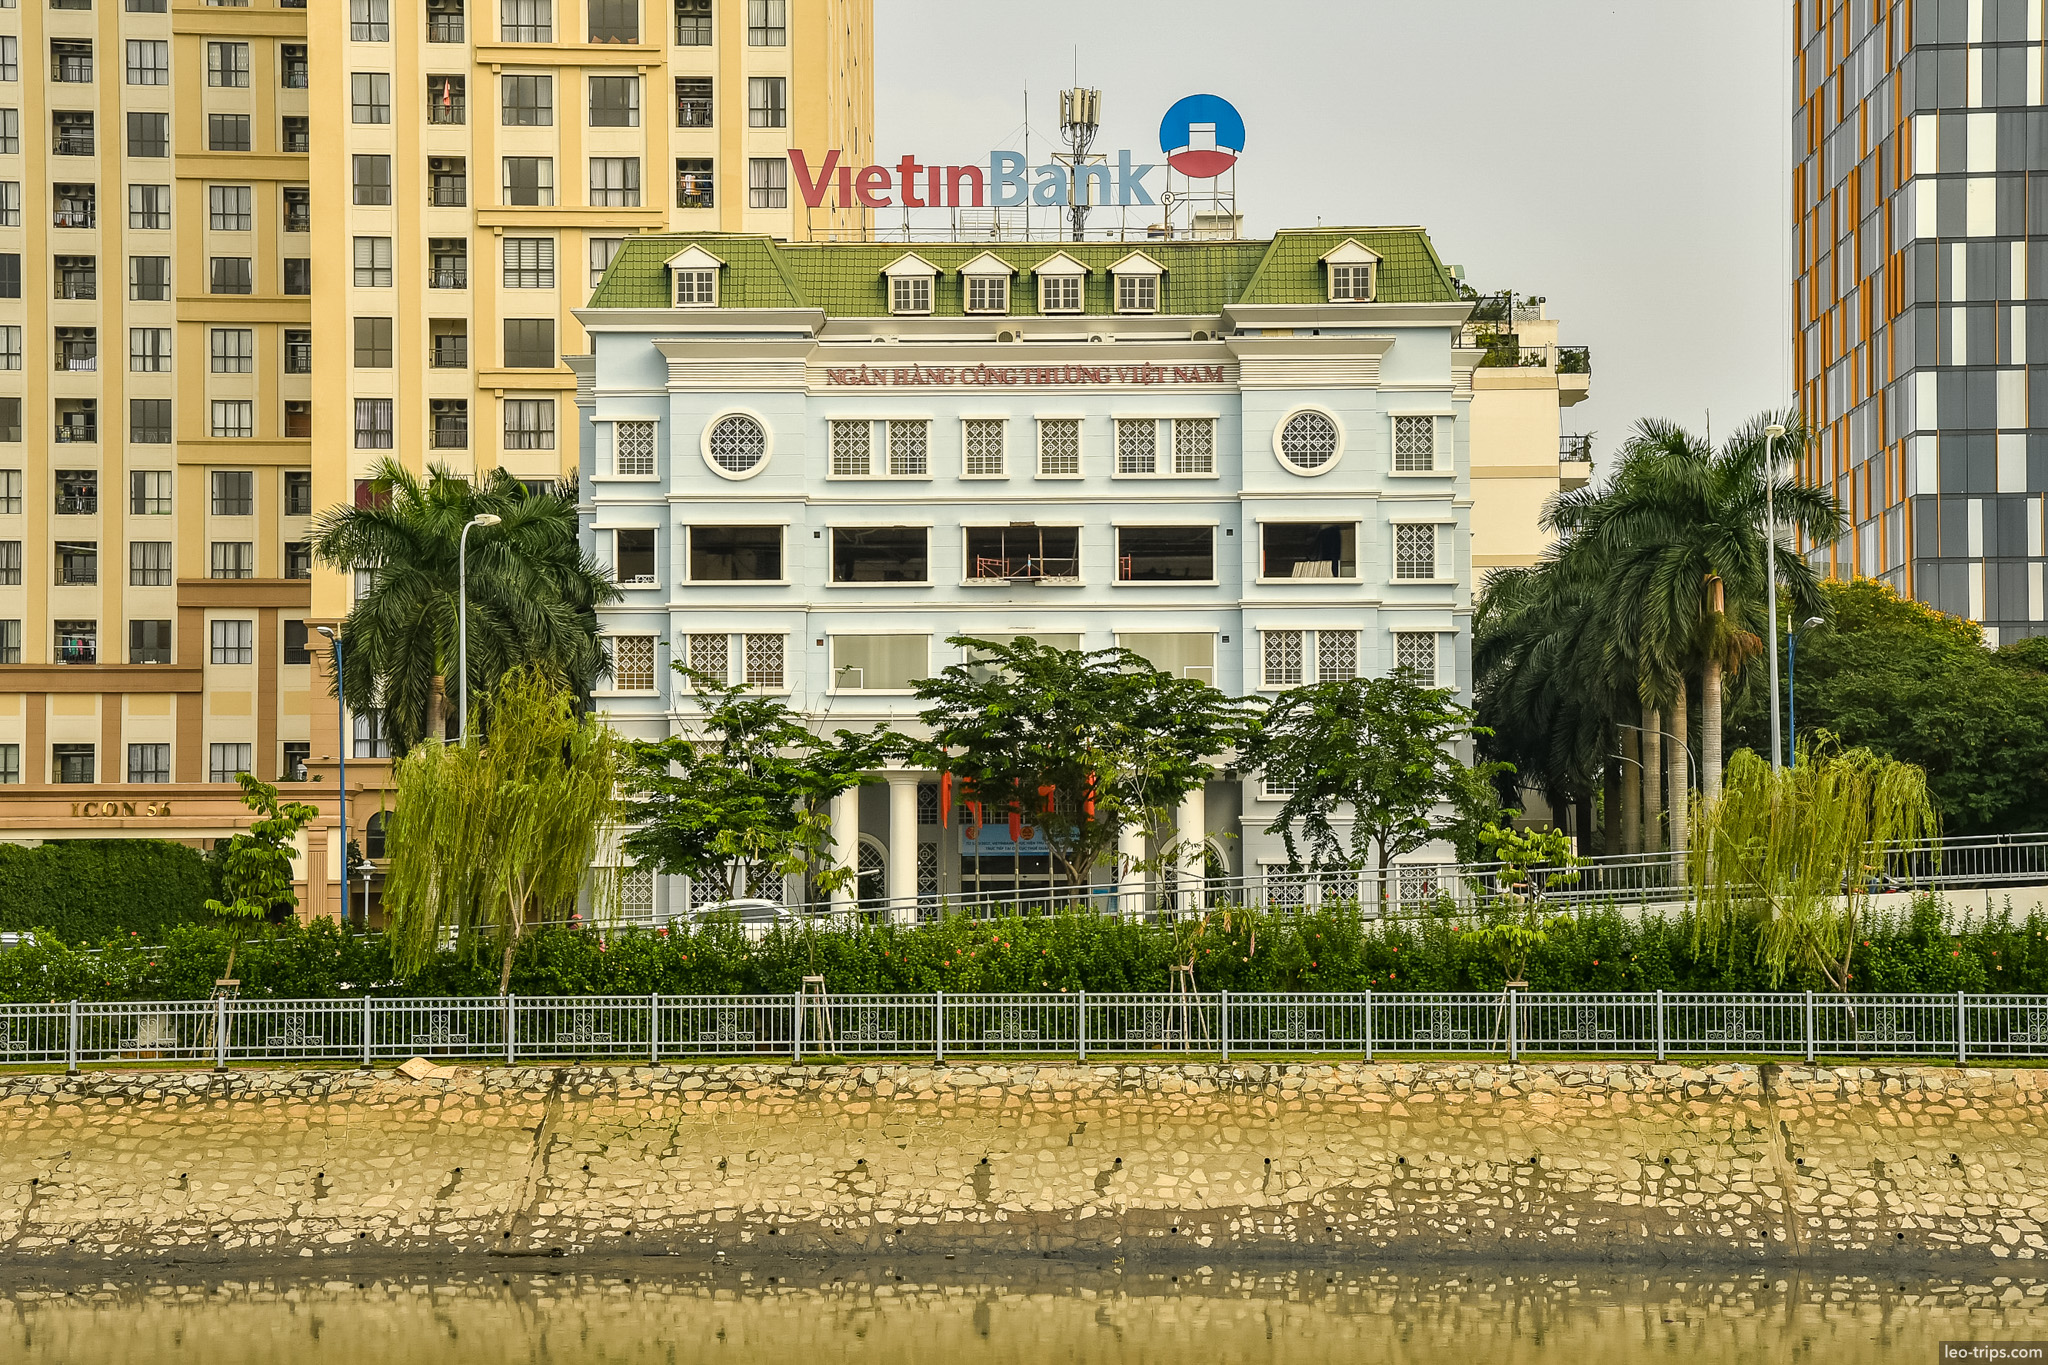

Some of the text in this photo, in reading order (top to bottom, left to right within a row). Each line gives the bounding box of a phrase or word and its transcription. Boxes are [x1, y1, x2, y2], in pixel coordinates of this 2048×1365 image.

[787, 149, 1156, 208] VietinBank
[826, 363, 888, 386] NGÂN
[893, 362, 957, 386] HÀNG
[1116, 361, 1168, 386] VIỆT
[1173, 365, 1225, 384] NAM
[71, 801, 171, 818] ICON 56
